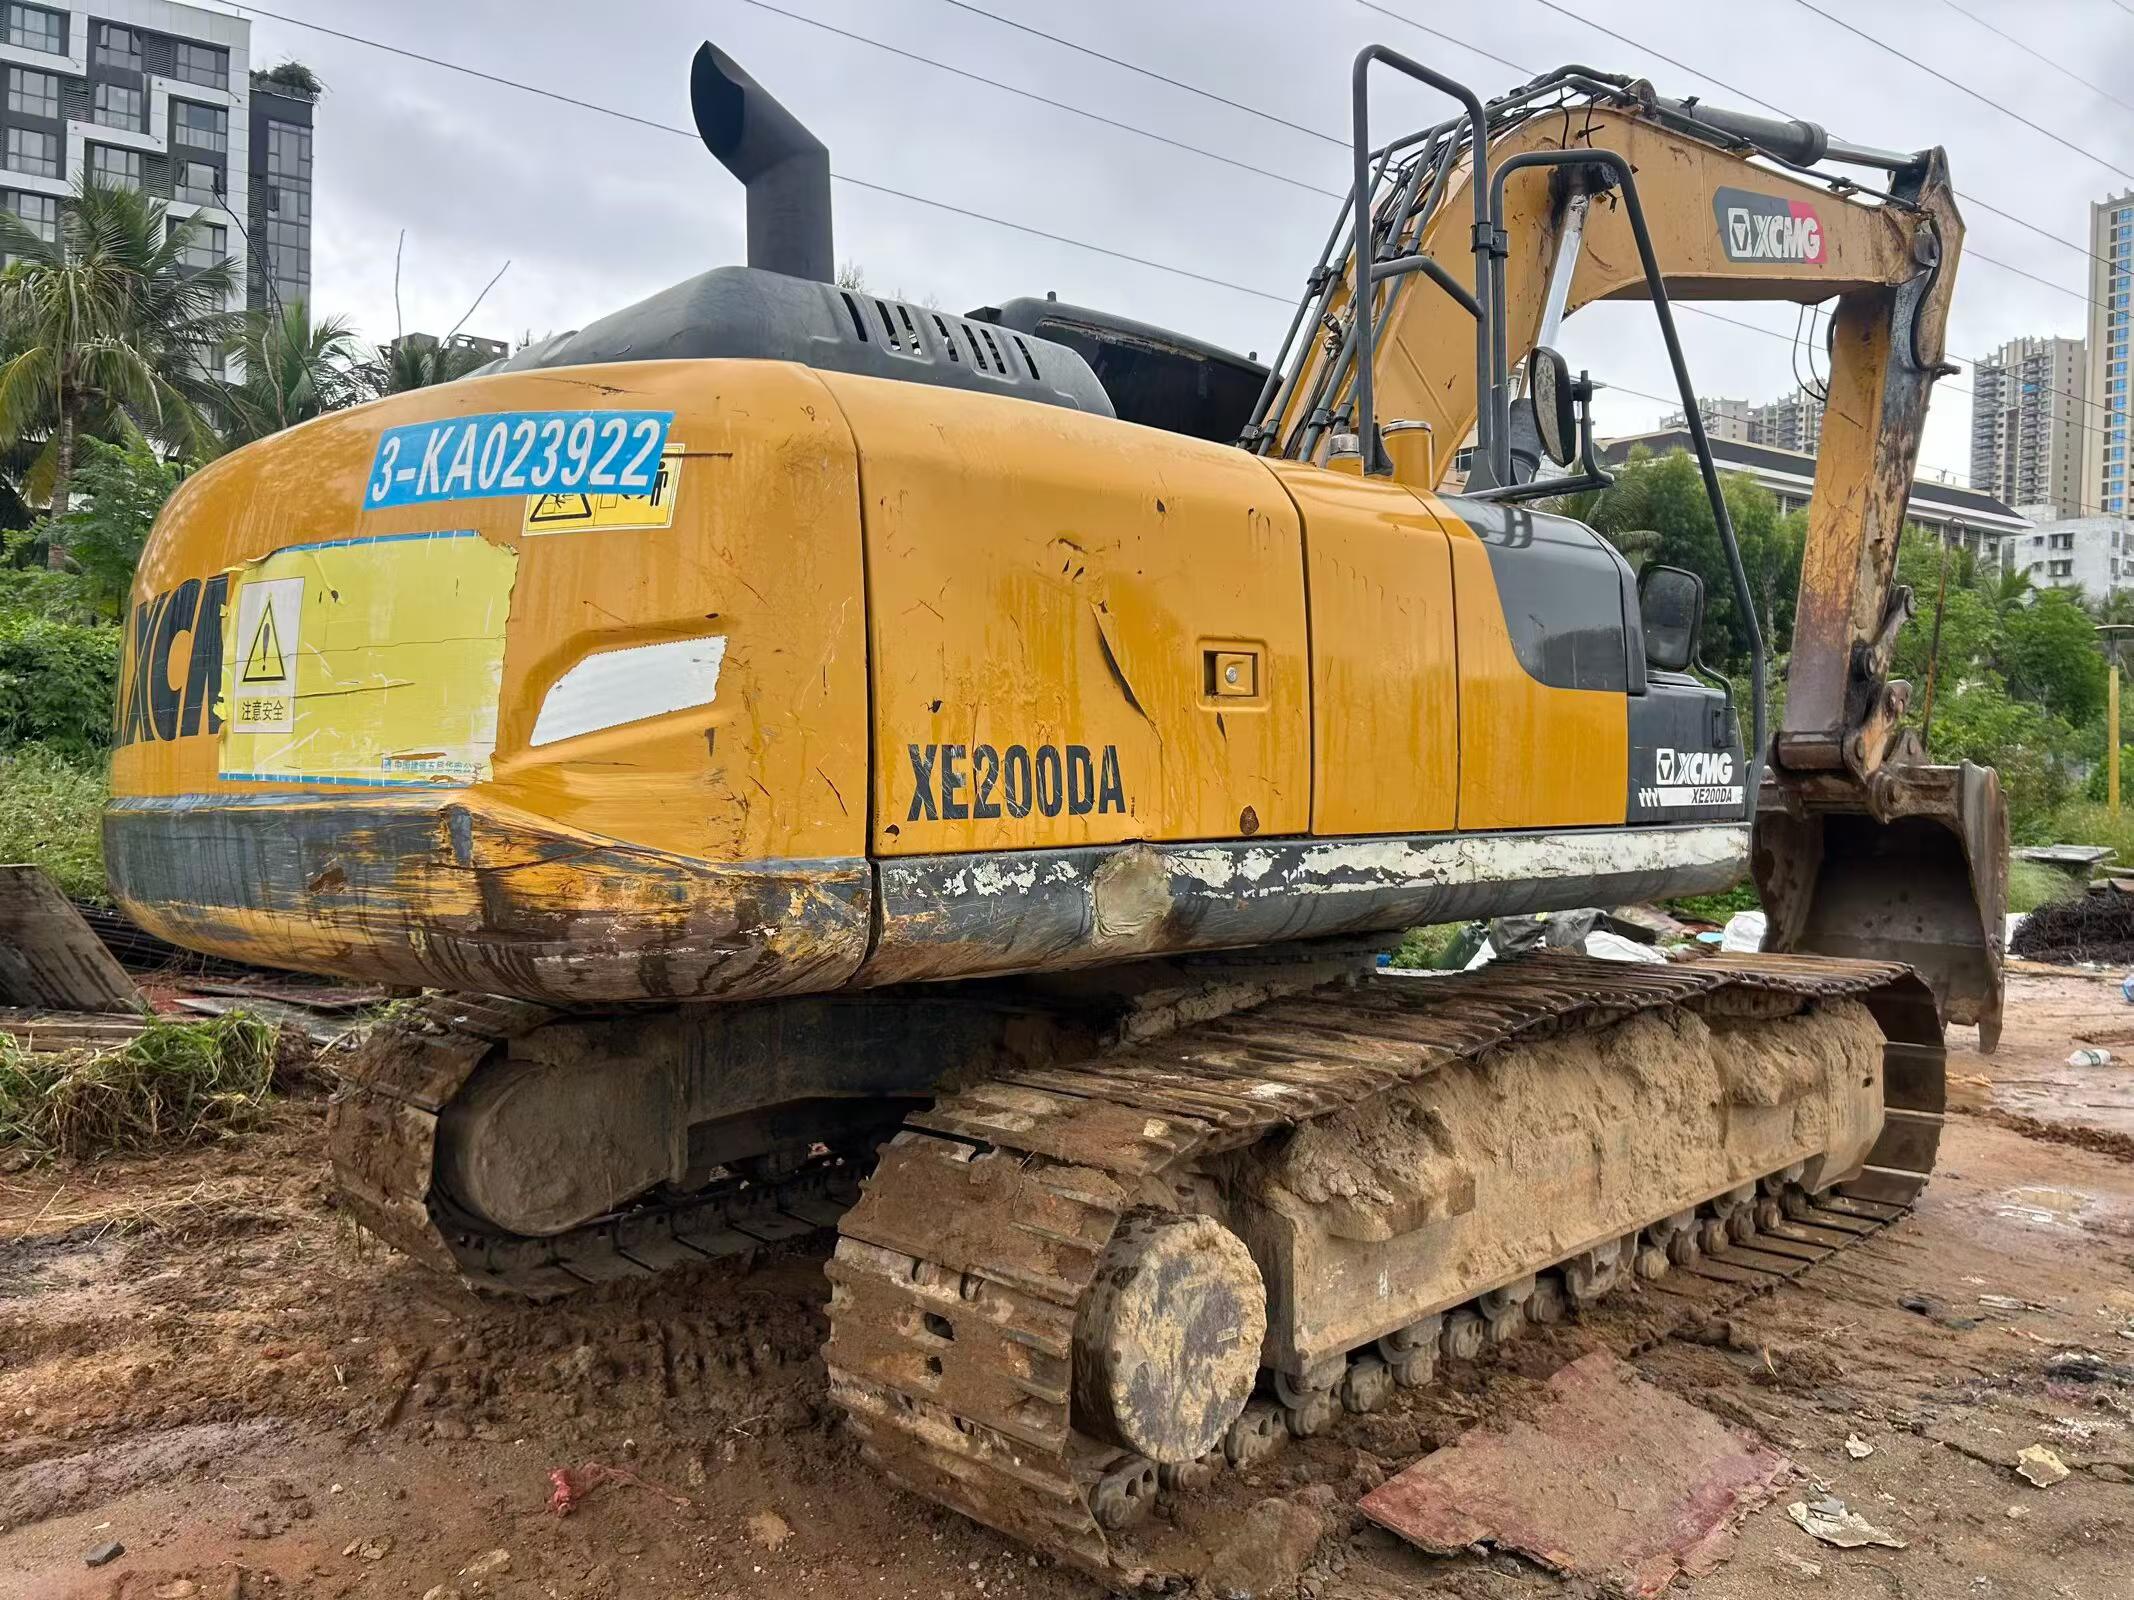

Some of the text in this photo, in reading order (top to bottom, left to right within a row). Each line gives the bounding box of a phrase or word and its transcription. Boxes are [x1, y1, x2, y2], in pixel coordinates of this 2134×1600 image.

[1752, 214, 1820, 260] XCMG
[372, 418, 661, 501] 3-KA023922
[241, 699, 284, 721] 注意安全
[906, 743, 1127, 822] XE200DA
[1673, 752, 1734, 786] XCMG
[1691, 787, 1733, 804] XE200DA
